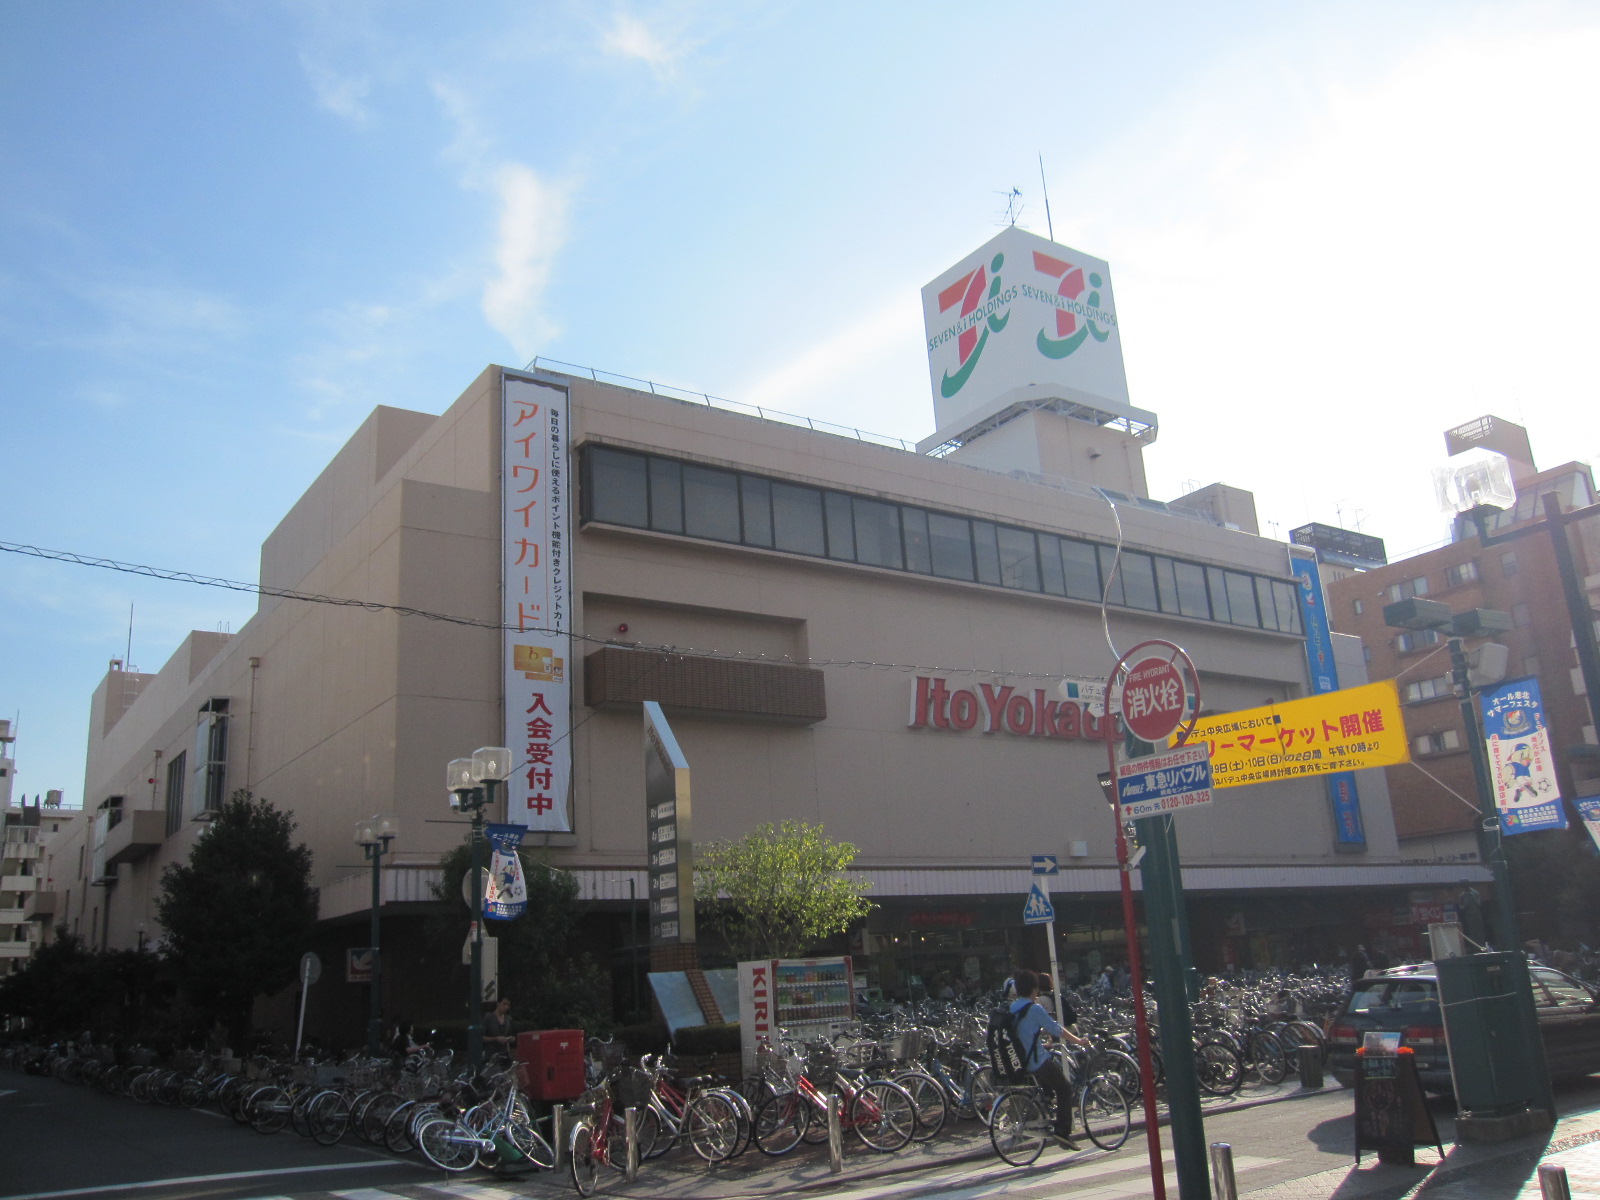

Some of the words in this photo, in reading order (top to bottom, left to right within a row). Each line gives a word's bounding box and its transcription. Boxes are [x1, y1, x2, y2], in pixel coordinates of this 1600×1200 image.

[968, 285, 1018, 326] HOLDINGS
[1067, 301, 1117, 326] HOLDINGS
[512, 399, 541, 632] アイワイカード
[550, 408, 563, 637] 毎日の暮らしに使えるポイント機能付きクレジットカード
[1129, 672, 1142, 683] FIRE
[1143, 664, 1170, 679] HYDRANT
[1126, 678, 1181, 720] 消火栓
[1486, 700, 1539, 717] サマーフェスタ
[1492, 691, 1530, 706] オール港北
[1184, 709, 1385, 758] リーマーケット開催
[525, 692, 554, 816] 入会受付中
[1144, 764, 1207, 792] 東急リバブル
[1133, 805, 1152, 815] 60m
[1161, 791, 1210, 809] 0120-109-325
[994, 1047, 1007, 1075] YONEX
[1006, 1042, 1023, 1072] YONEX
